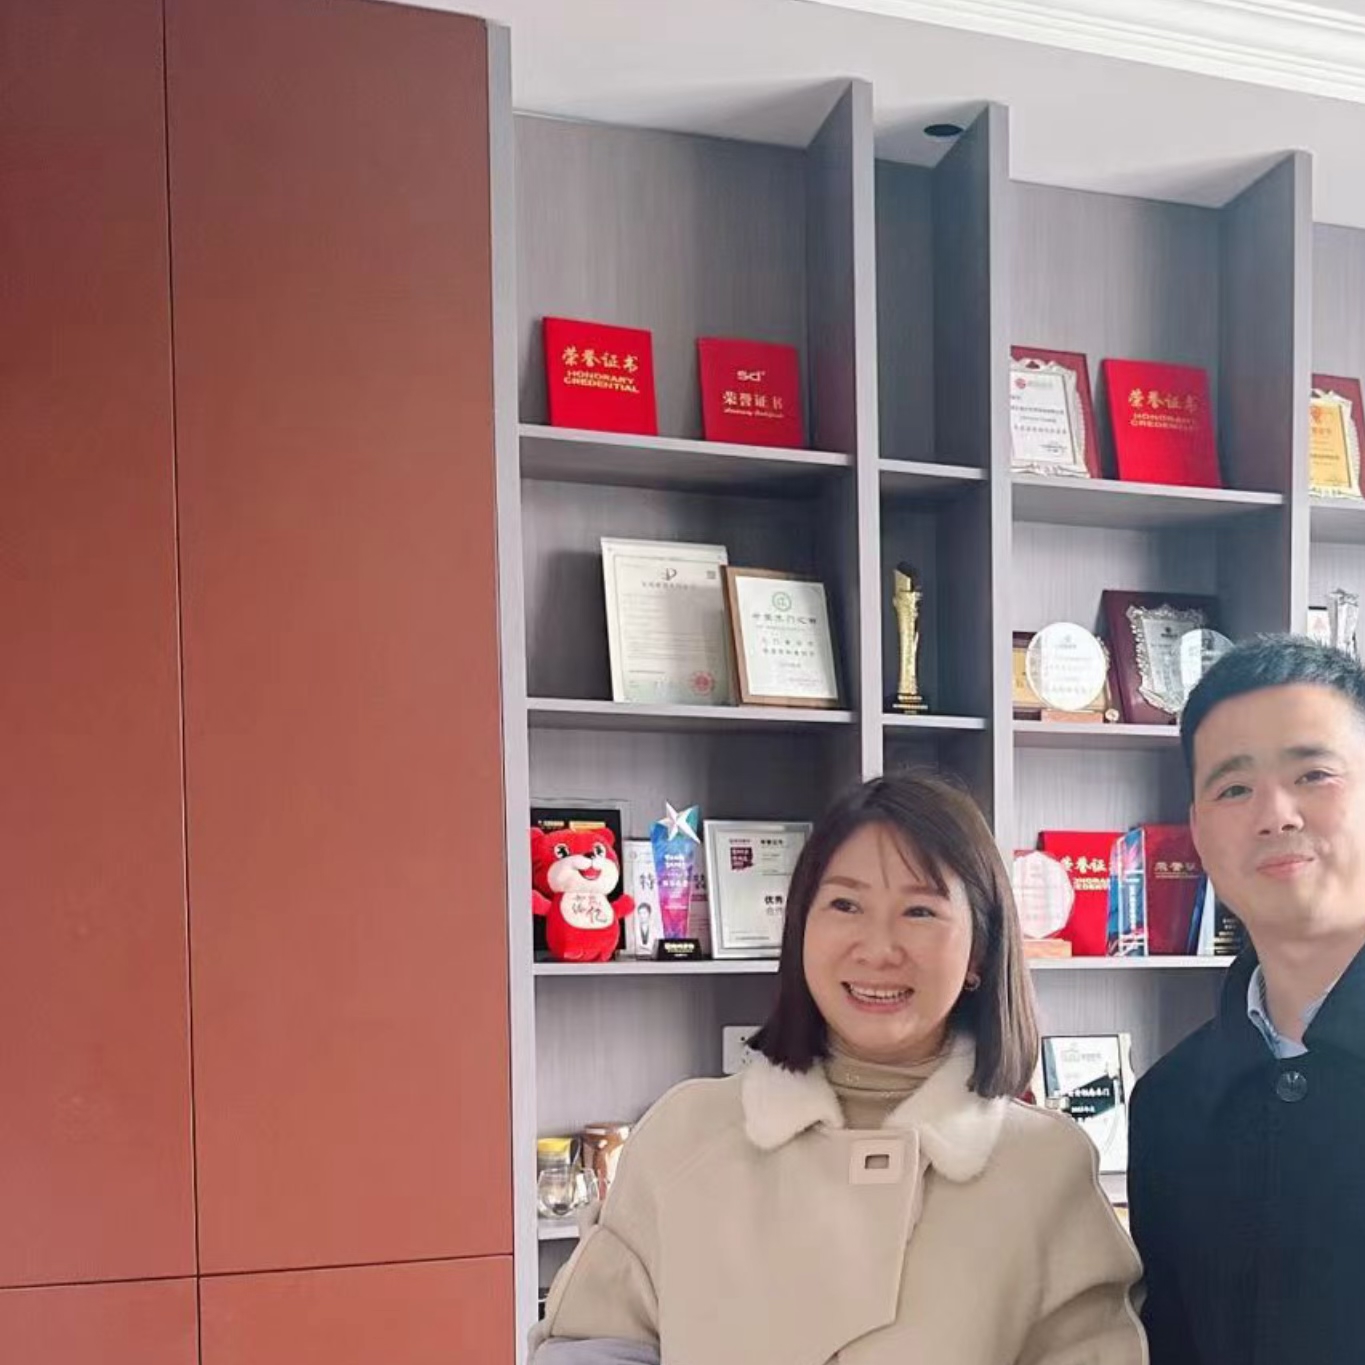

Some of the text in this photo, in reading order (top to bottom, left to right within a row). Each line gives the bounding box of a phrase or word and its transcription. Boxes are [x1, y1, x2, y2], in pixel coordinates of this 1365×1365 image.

[561, 345, 639, 373] 荣誉证书
[563, 377, 640, 394] CREDENTIAL
[567, 370, 635, 385] HONORARY
[722, 391, 783, 410] 荣誉证书
[1127, 388, 1199, 413] 荣誉证书
